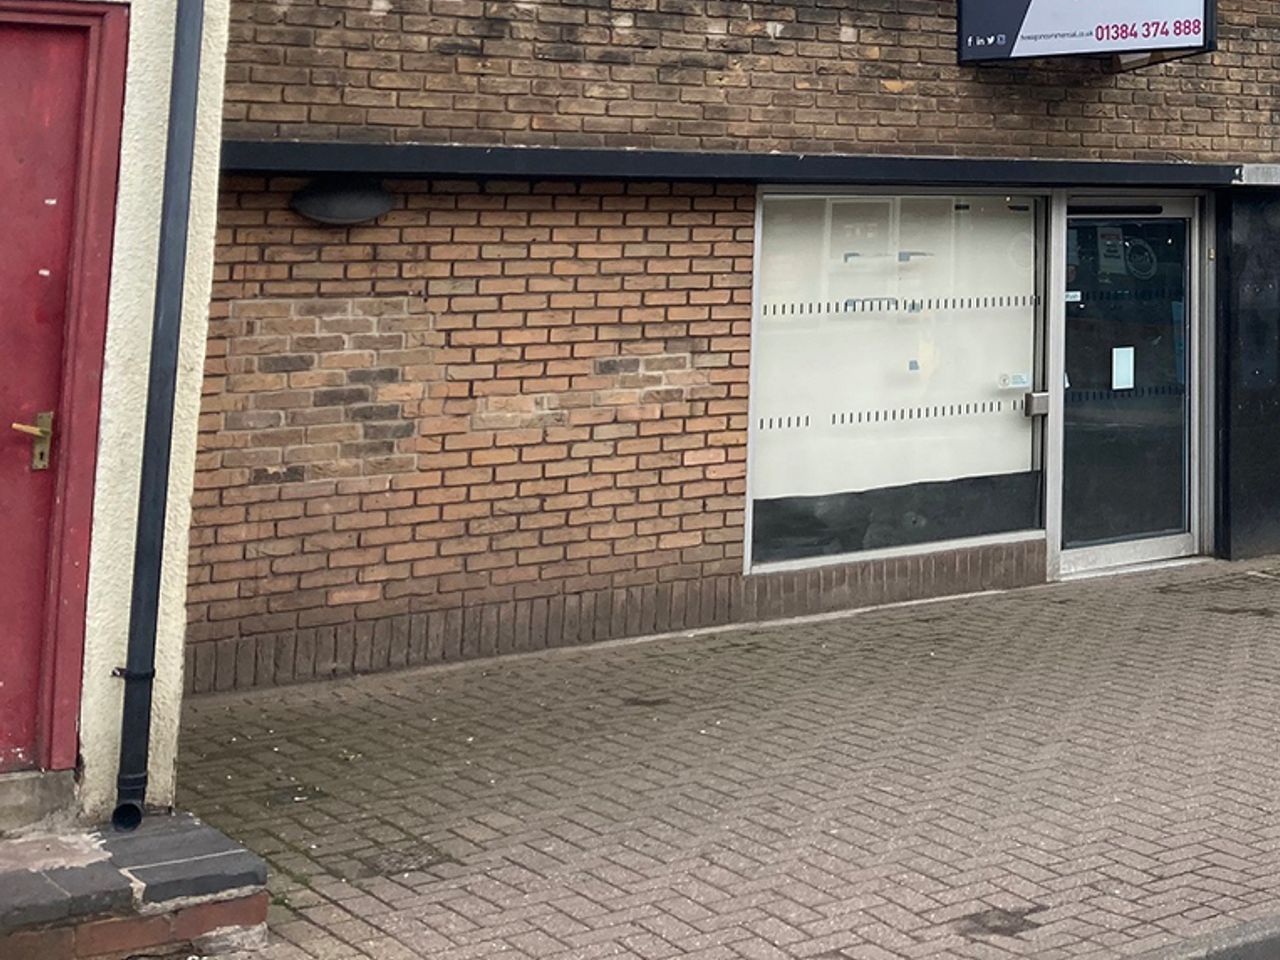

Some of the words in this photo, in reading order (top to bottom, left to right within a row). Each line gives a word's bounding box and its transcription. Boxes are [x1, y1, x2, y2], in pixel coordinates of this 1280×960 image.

[1095, 22, 1138, 41] 01384
[1141, 20, 1170, 39] 374
[1173, 18, 1202, 36] 888
